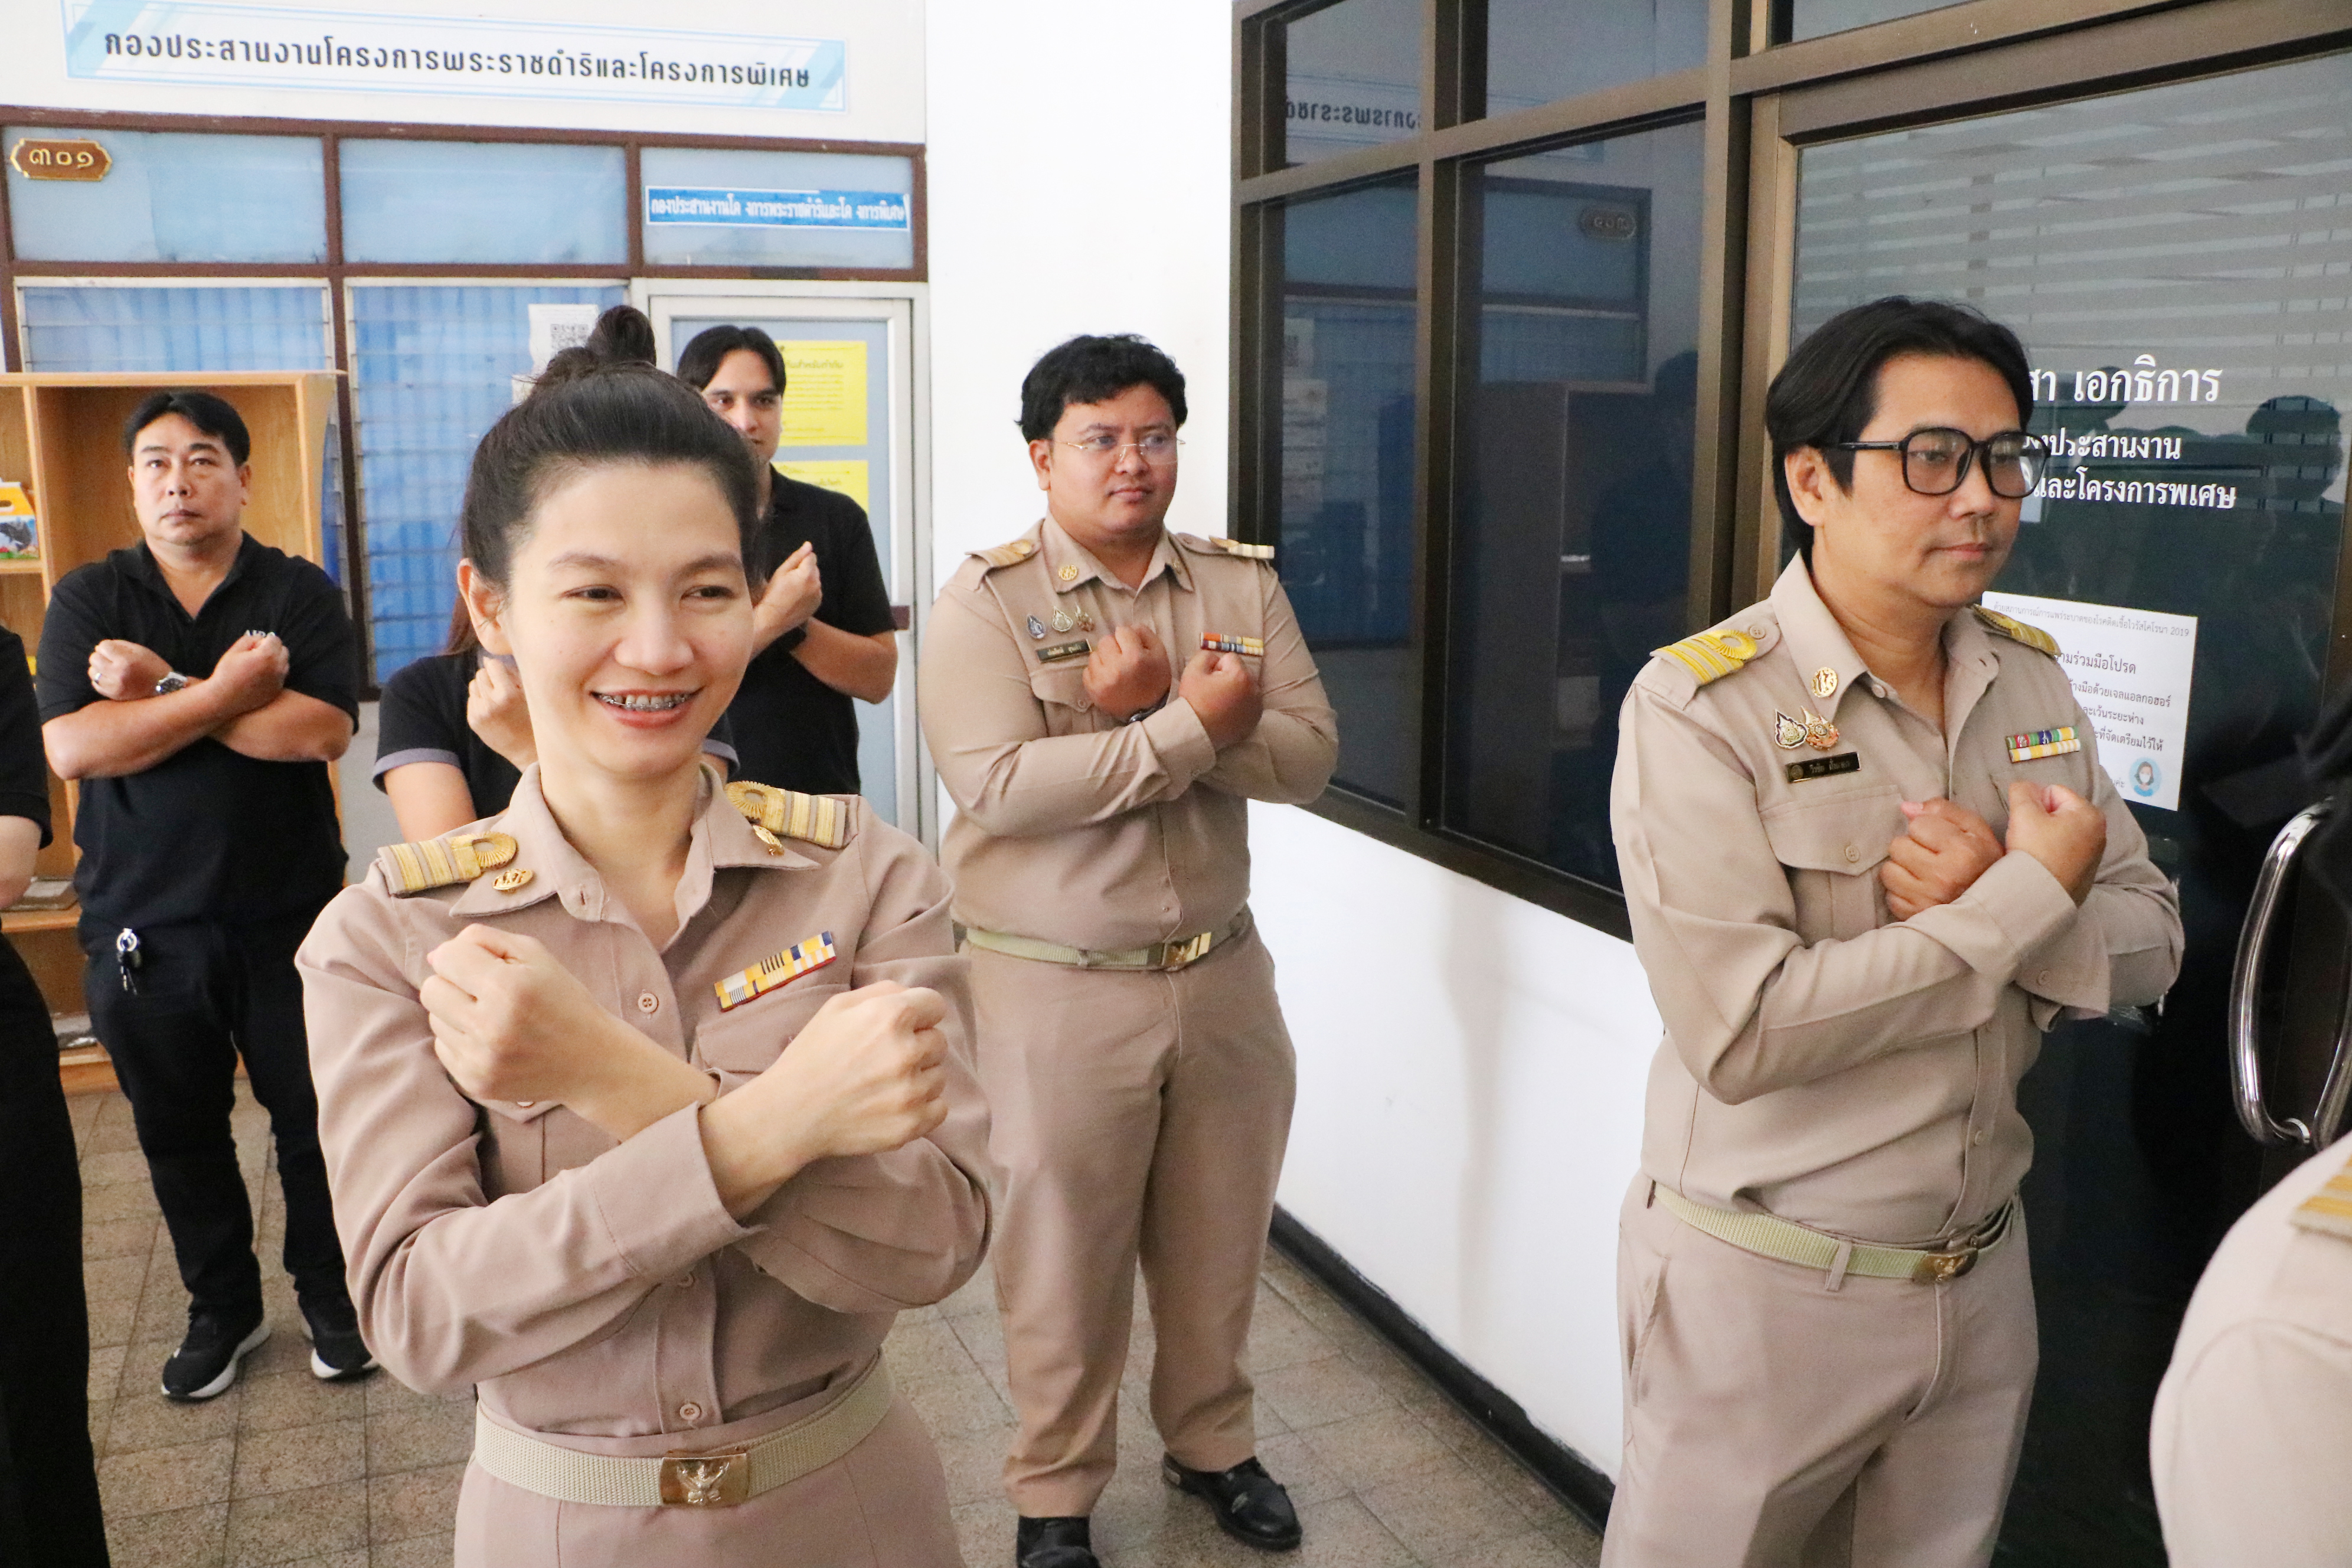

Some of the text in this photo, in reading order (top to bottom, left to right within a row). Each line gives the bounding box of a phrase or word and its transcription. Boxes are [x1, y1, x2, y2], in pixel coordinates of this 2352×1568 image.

[104, 32, 809, 87] กองประสานงานโครงการพระราชดำริและโครงการพิเศษ
[28, 148, 95, 168] ๓๐๑
[2074, 353, 2224, 403] เอกธิการ
[2170, 626, 2189, 636] 2019
[2069, 678, 2171, 707] ้างมือด้วยเจลแอลกอฮอร์
[2093, 726, 2164, 752] ะที่จัดเตรียมไว้ให้
